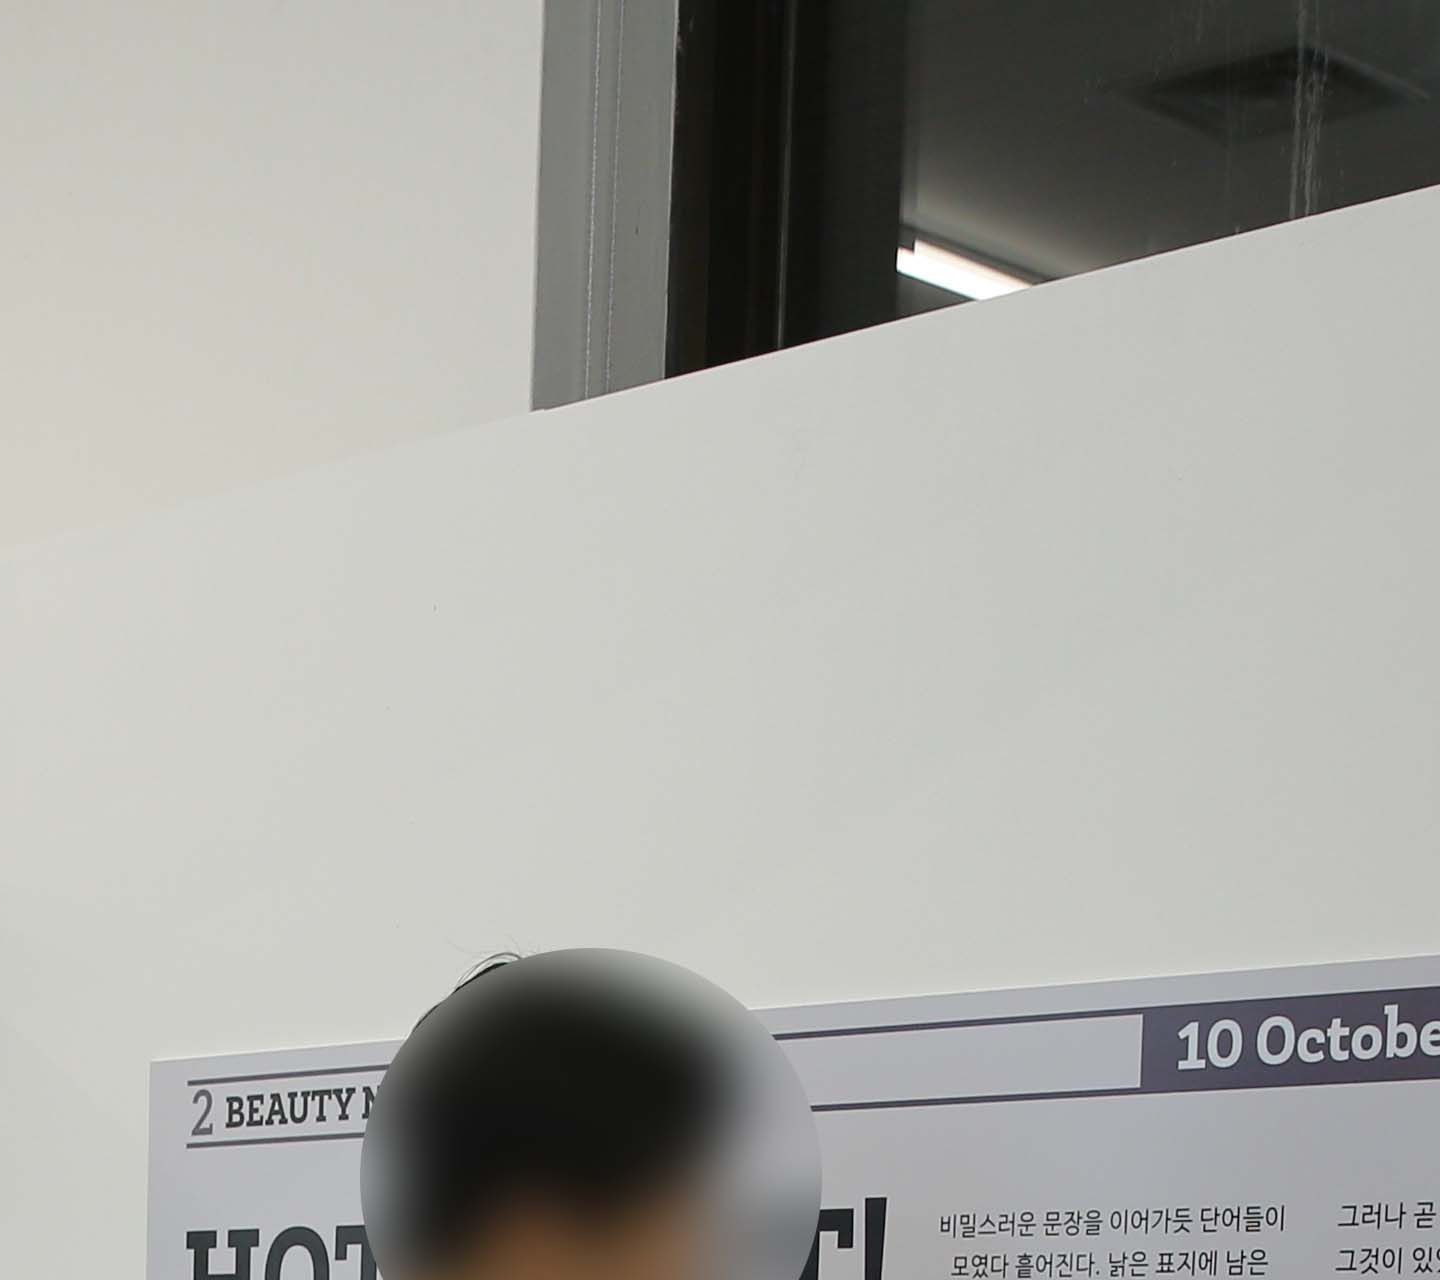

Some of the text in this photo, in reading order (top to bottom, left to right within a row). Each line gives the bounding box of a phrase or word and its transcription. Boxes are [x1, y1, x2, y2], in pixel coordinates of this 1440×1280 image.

[1177, 1019, 1243, 1070] 10
[191, 1088, 213, 1136] 2
[225, 1087, 356, 1129] BEAUTY
[939, 1205, 1285, 1238] 비밀스러운 문장을 이어가듯 단어들이
[1337, 1202, 1406, 1229] 그러나
[1413, 1201, 1437, 1229] 곧
[951, 1253, 1009, 1279] 모였다
[1015, 1252, 1101, 1278] 흩어진다.
[1155, 1250, 1218, 1276] 표지에
[1226, 1249, 1269, 1276] 남은
[1336, 1247, 1403, 1274] 그것이
